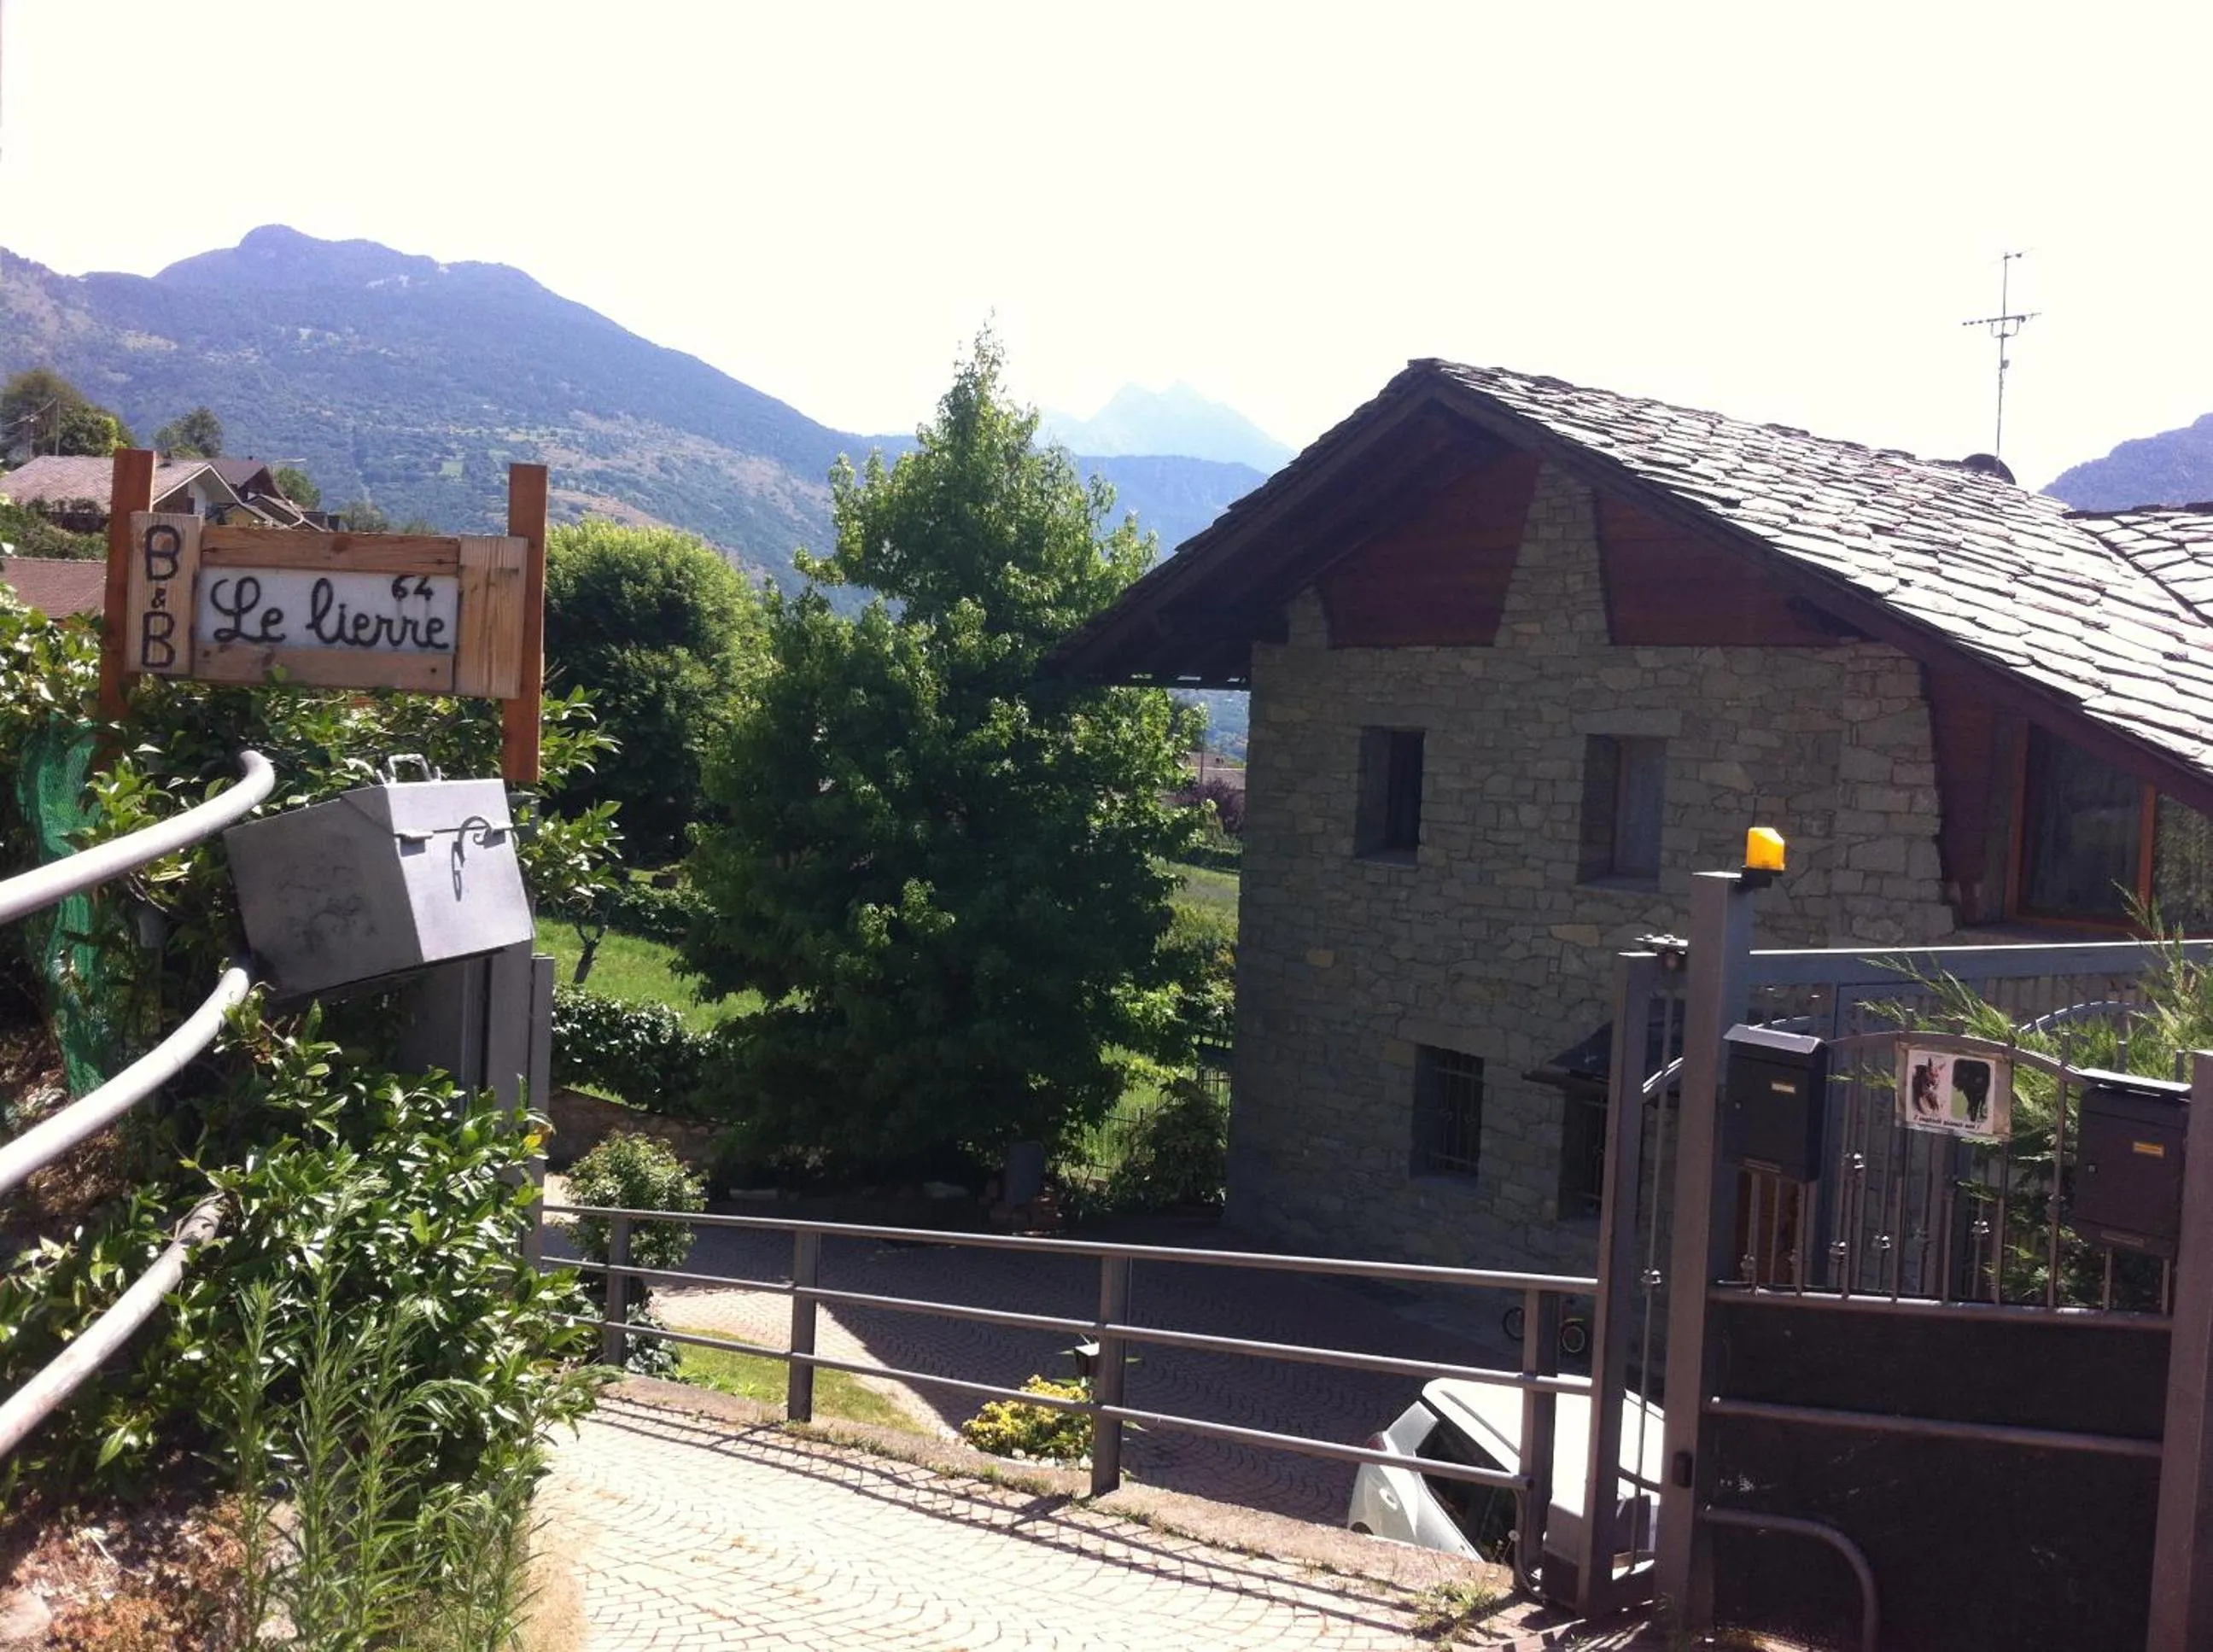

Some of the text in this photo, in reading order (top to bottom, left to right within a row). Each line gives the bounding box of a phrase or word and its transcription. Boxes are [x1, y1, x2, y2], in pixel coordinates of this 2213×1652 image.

[209, 576, 450, 650] Le lierre
[391, 575, 434, 601] 64
